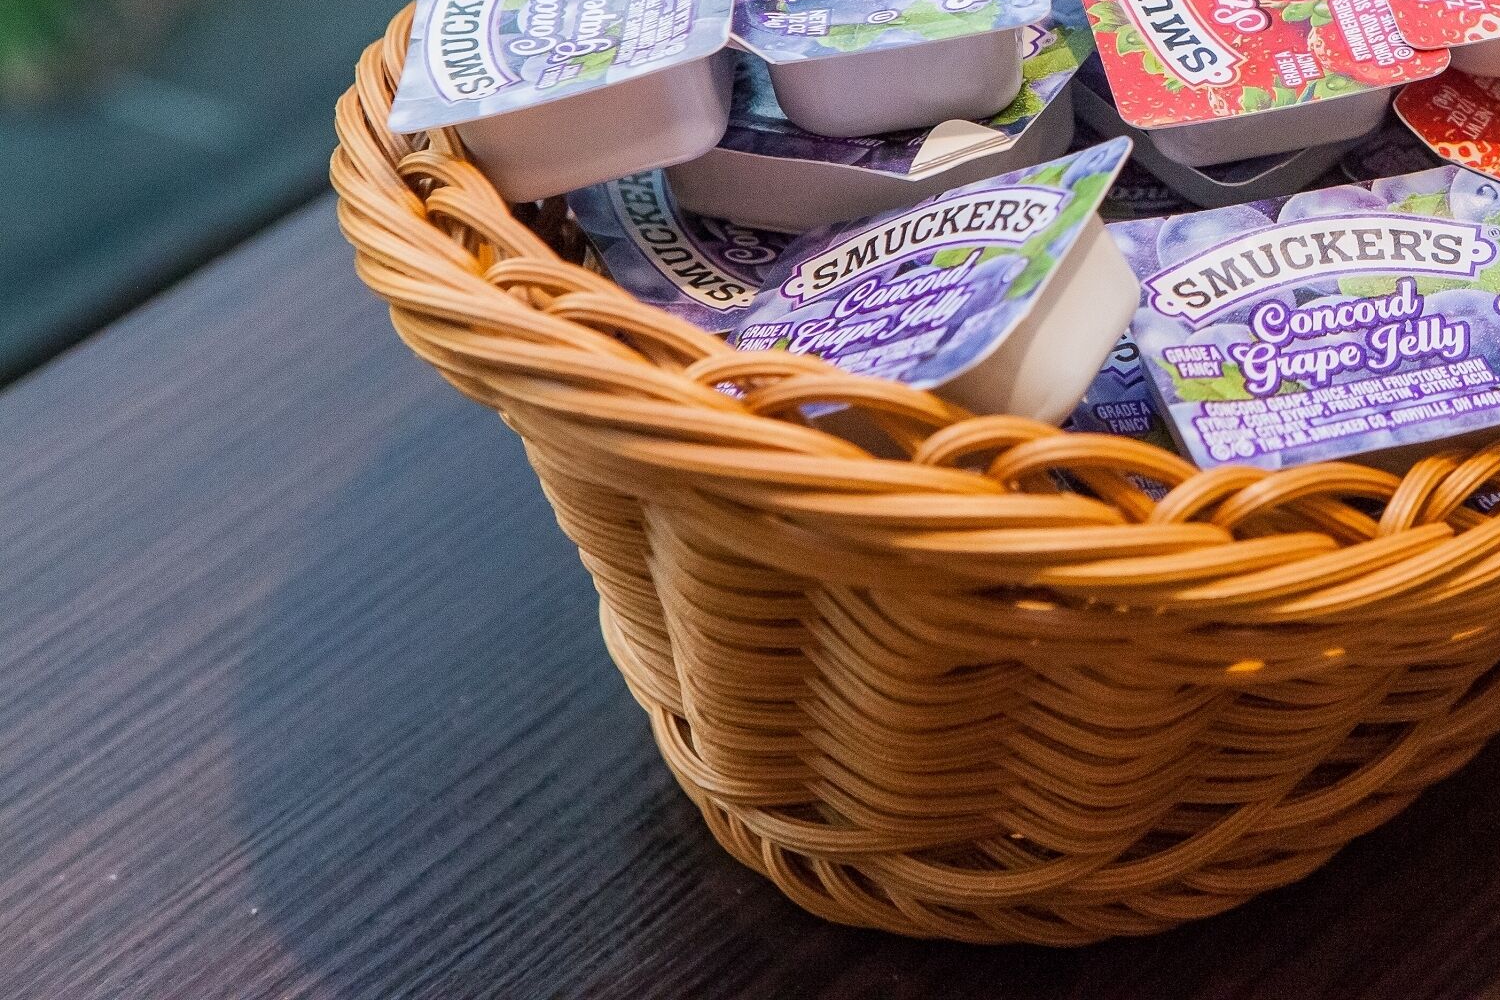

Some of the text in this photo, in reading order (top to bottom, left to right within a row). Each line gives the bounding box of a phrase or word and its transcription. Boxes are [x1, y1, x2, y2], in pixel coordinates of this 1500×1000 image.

[1358, 8, 1385, 41] SYRUP,
[1297, 53, 1320, 79] FANCY
[1370, 42, 1395, 64] CORN
[1283, 60, 1301, 87] GRADE
[813, 199, 1047, 290] SMUCKER'S
[1171, 228, 1463, 309] SMUCKER'S
[837, 250, 983, 319] Concord
[790, 319, 888, 358] Grape
[877, 284, 975, 340] Jelly
[1253, 280, 1418, 344] Concord
[737, 339, 776, 351] FANCY
[743, 325, 787, 339] GRADE A
[1165, 346, 1222, 362] GRADE A
[1232, 318, 1465, 393] Grape Jelly
[1179, 361, 1221, 377] FANCY
[1384, 367, 1451, 387] FRUCTOSE
[1450, 359, 1487, 376] CORN
[1419, 378, 1464, 394] CITRIC
[1463, 371, 1500, 386] ACID,
[1096, 402, 1151, 420] GRADE A
[1109, 416, 1151, 433] FANCY
